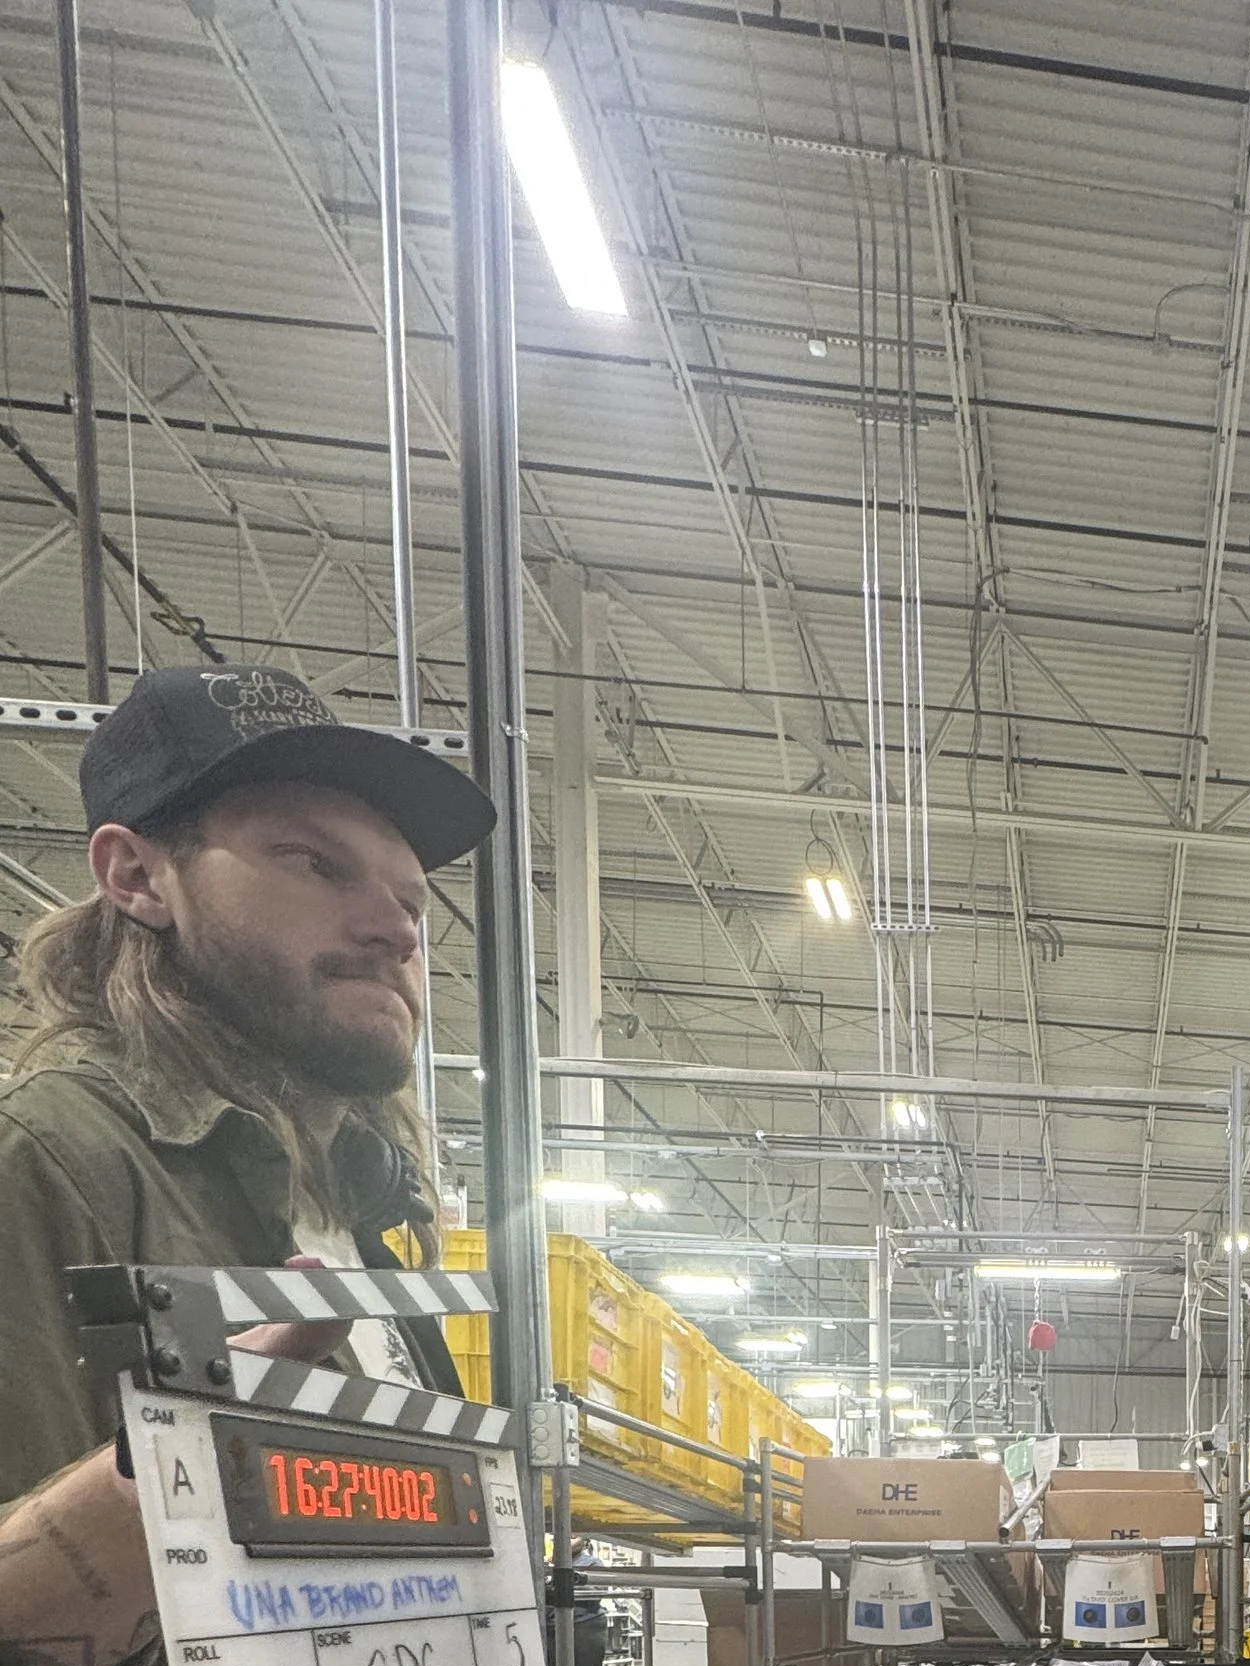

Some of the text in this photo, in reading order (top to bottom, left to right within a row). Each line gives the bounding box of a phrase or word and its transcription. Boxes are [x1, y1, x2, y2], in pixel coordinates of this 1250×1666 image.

[141, 1406, 175, 1426] CAM
[173, 1457, 195, 1496] A
[881, 1483, 918, 1501] DHE
[166, 1549, 209, 1564] PROD
[298, 1581, 385, 1619] BRAND
[391, 1574, 463, 1611] ANTHEM
[471, 1616, 492, 1630] TAKE
[317, 1631, 353, 1647] SCENE
[183, 1645, 221, 1662] ROLL
